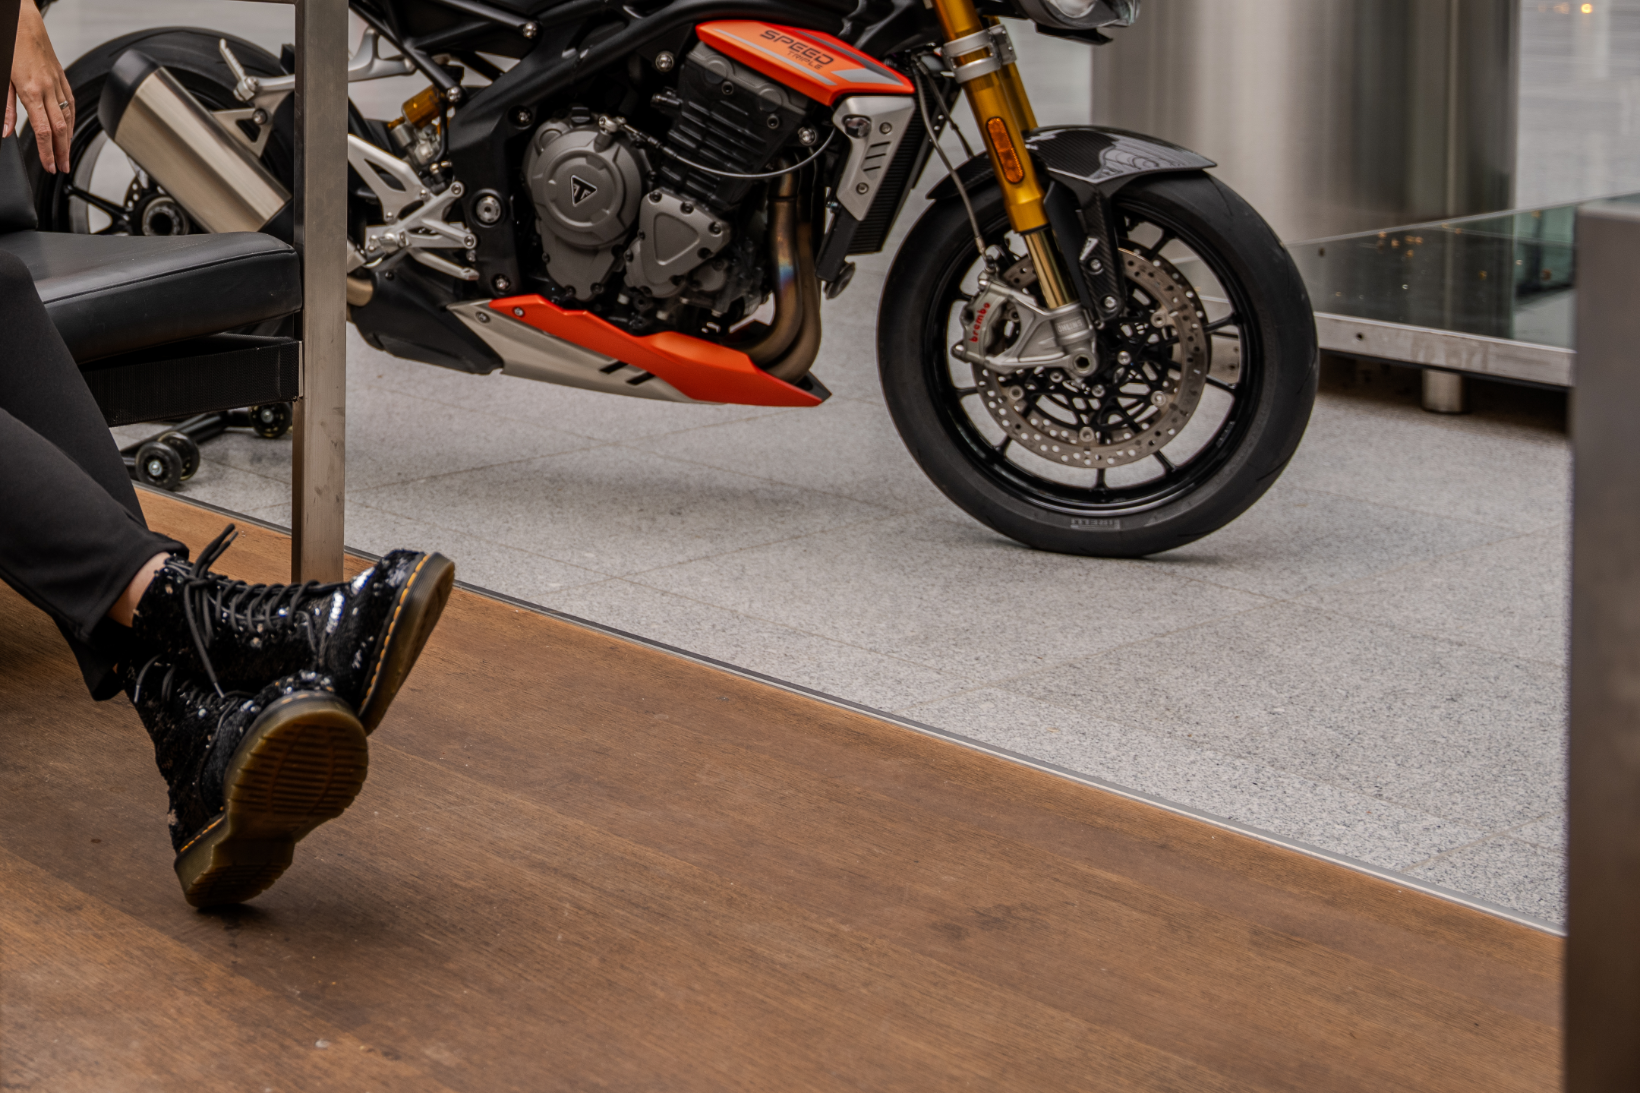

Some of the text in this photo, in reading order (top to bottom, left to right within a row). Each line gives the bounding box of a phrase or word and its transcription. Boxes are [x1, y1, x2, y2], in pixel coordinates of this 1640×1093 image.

[760, 29, 834, 65] SPEED
[787, 50, 823, 70] TRIPLE
[969, 302, 991, 343] brembo
